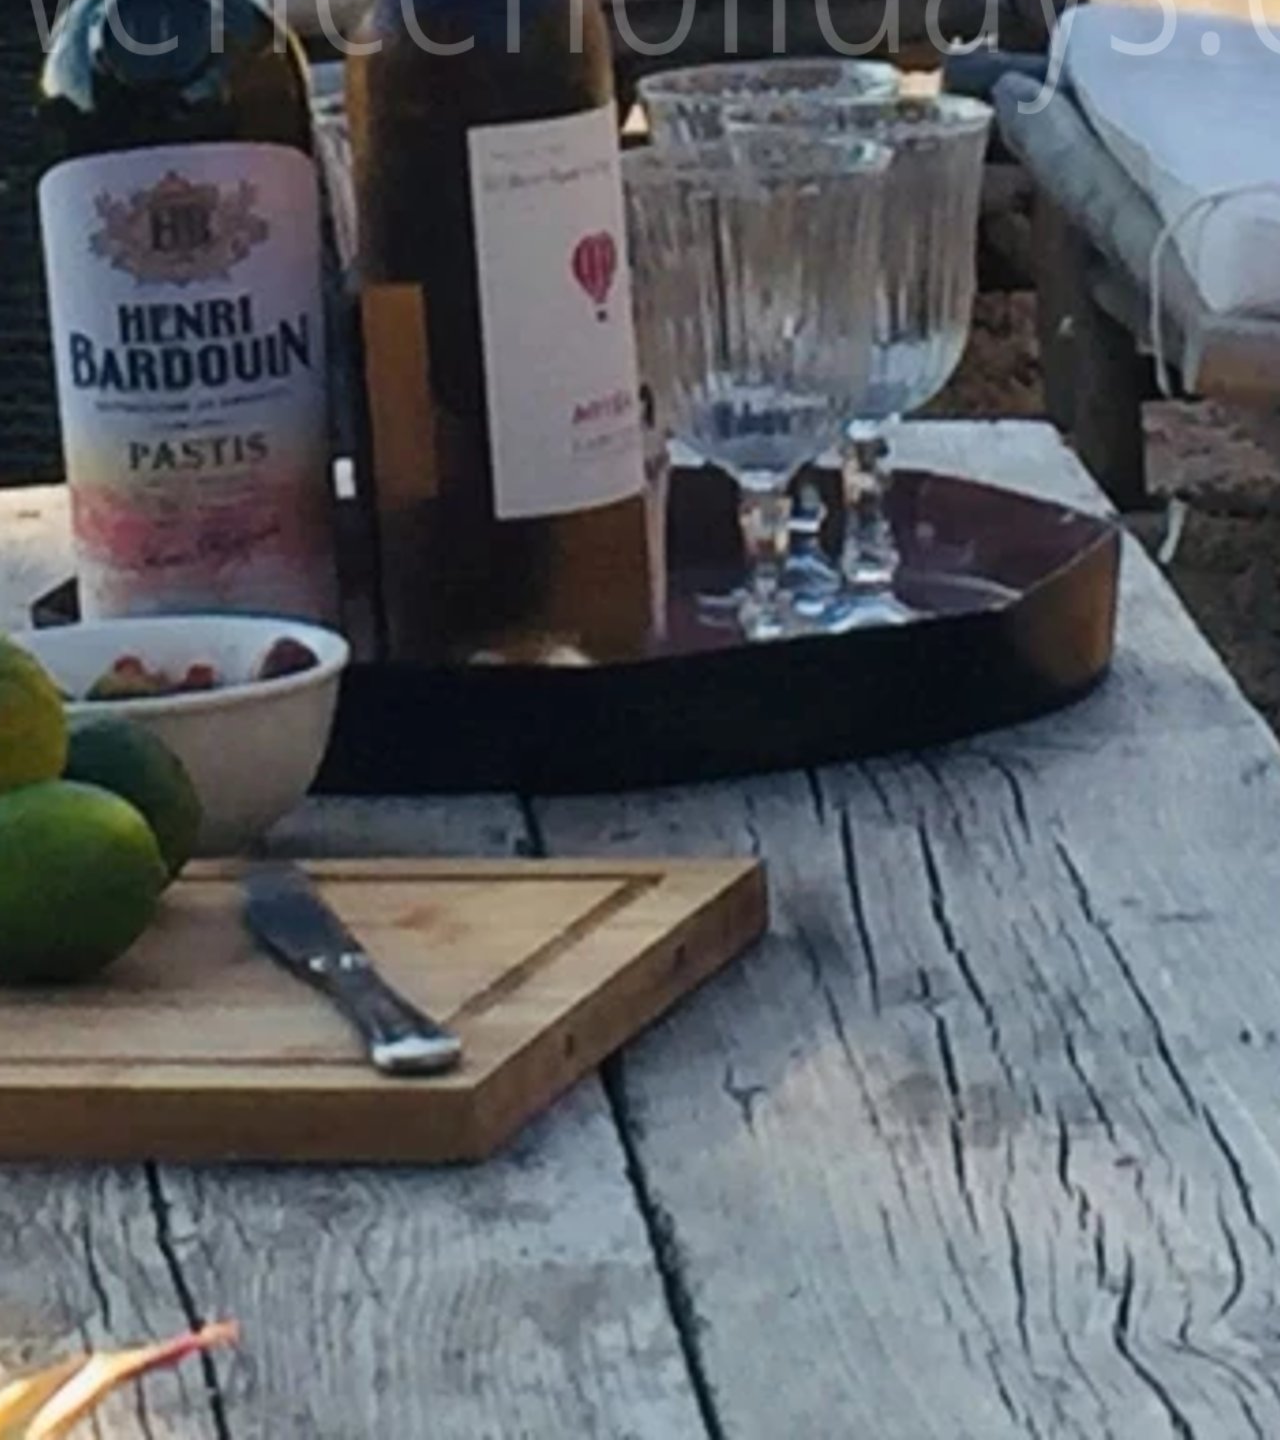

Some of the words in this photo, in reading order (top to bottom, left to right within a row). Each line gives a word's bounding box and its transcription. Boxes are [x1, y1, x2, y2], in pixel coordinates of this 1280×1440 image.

[118, 295, 253, 345] HENRI
[70, 312, 312, 392] BARDOUIN
[128, 432, 269, 471] PASTIS
